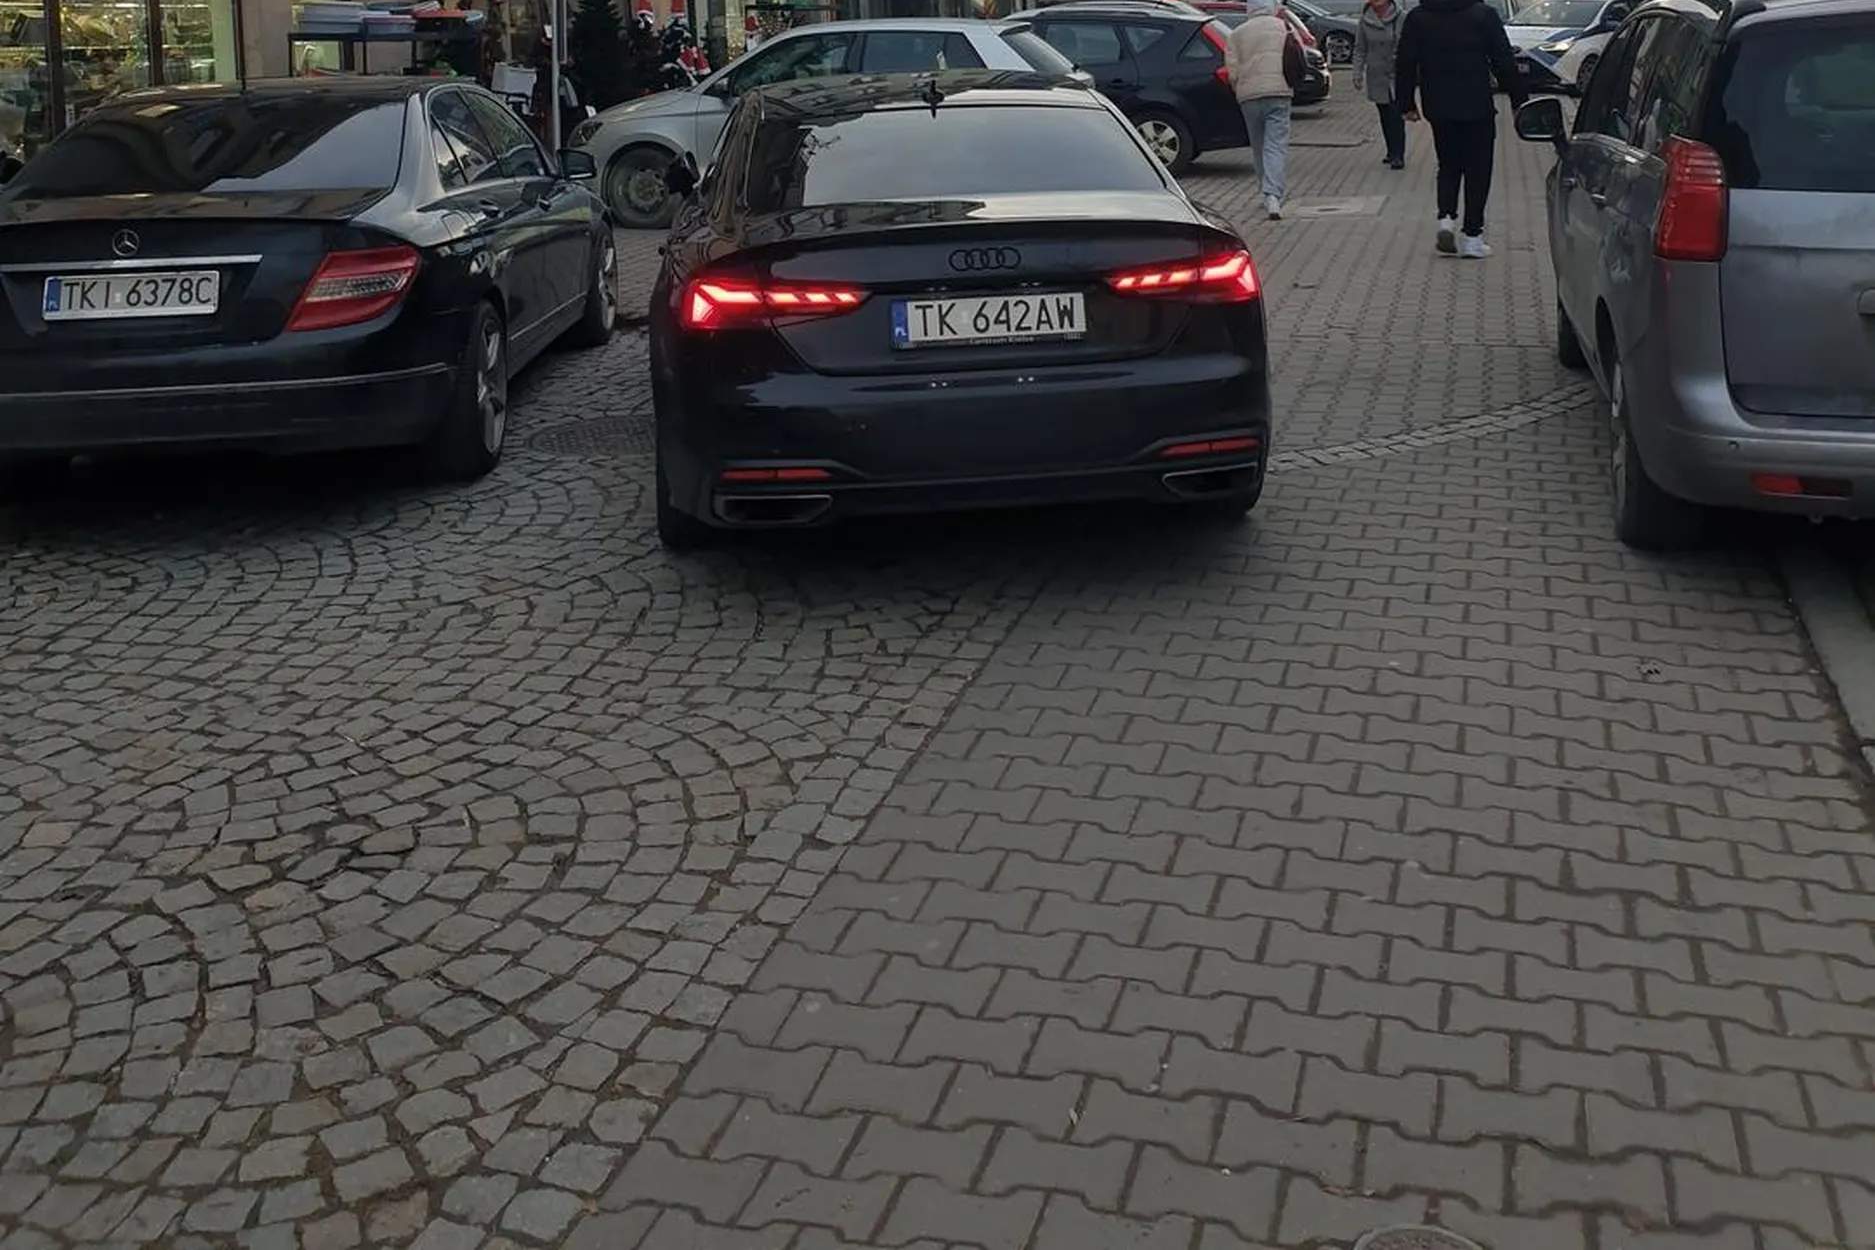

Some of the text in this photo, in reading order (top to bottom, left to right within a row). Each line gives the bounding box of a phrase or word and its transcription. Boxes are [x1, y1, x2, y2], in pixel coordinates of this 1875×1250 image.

[124, 276, 214, 308] 6378C
[914, 297, 1075, 337] TK 642AW
